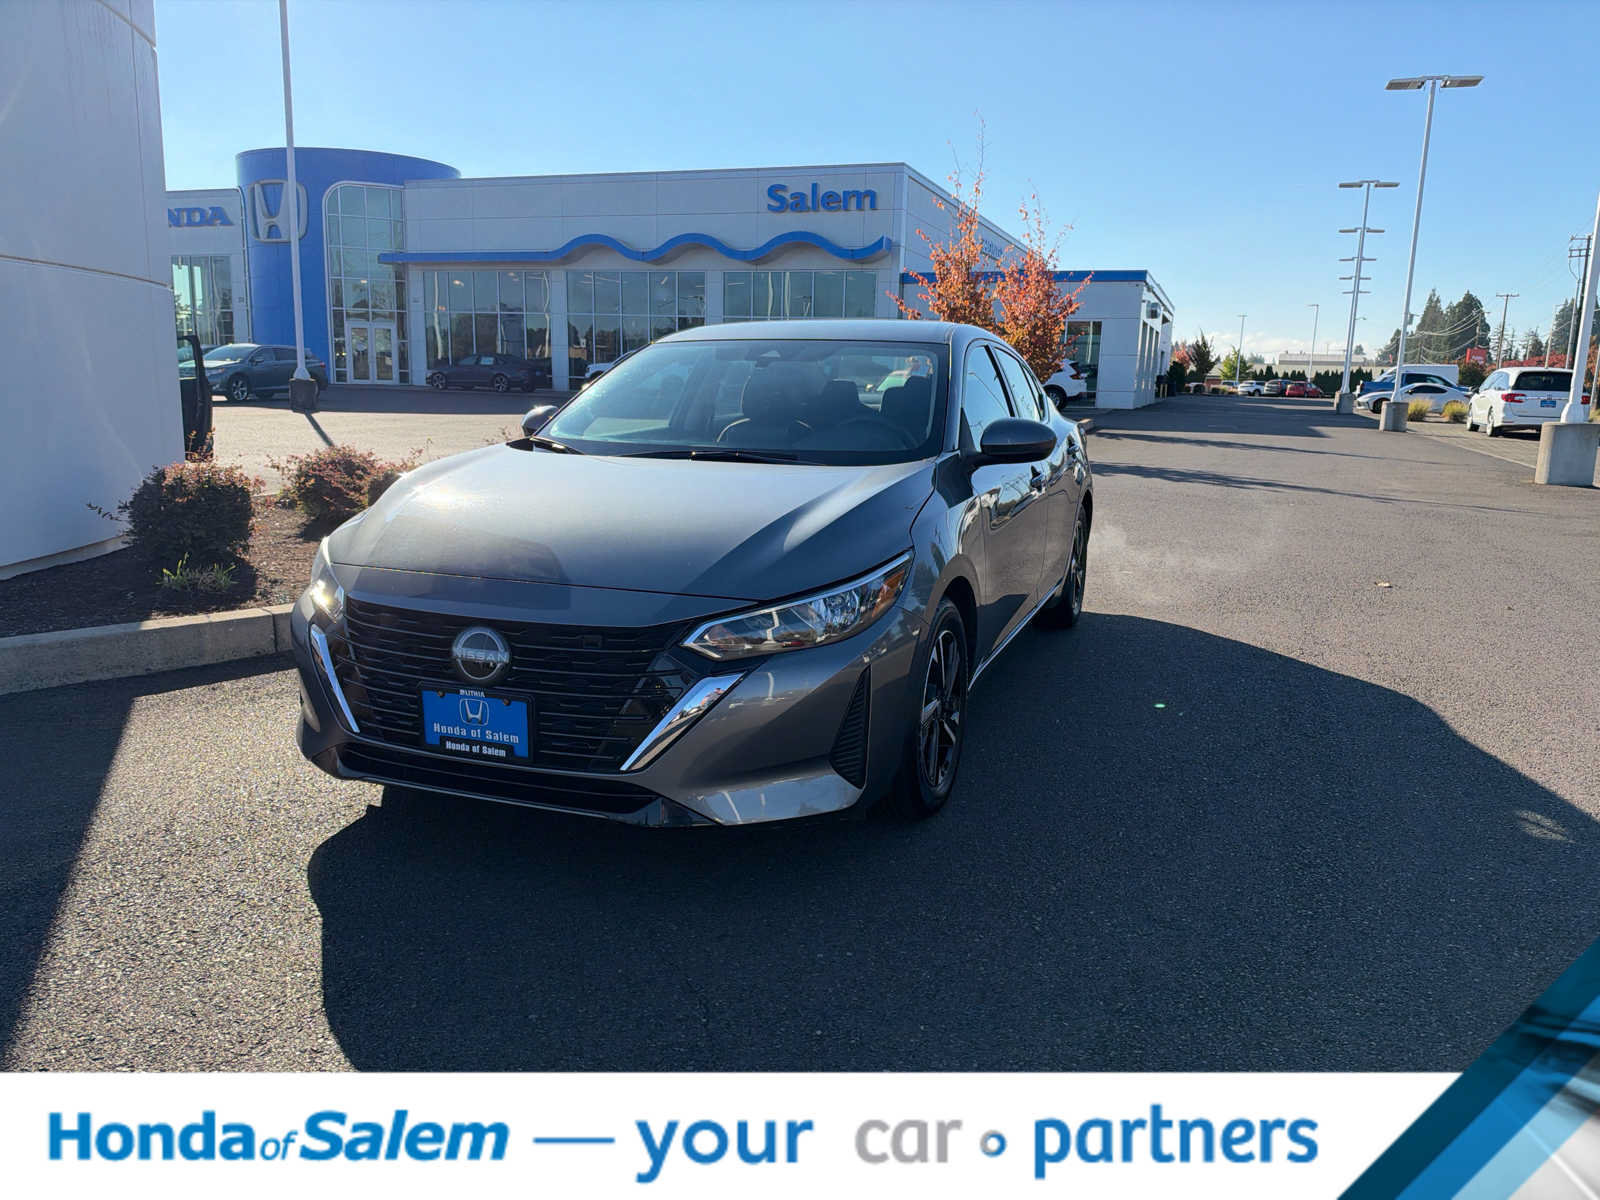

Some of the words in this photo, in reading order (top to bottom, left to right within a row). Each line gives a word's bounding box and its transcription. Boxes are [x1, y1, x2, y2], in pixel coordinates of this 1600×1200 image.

[767, 182, 877, 212] Salem
[453, 648, 510, 663] NISSAN
[433, 722, 467, 736] Honda
[470, 728, 481, 738] of
[485, 730, 519, 744] Salem
[446, 740, 470, 751] Honda
[472, 745, 480, 753] of
[482, 746, 506, 757] Salem
